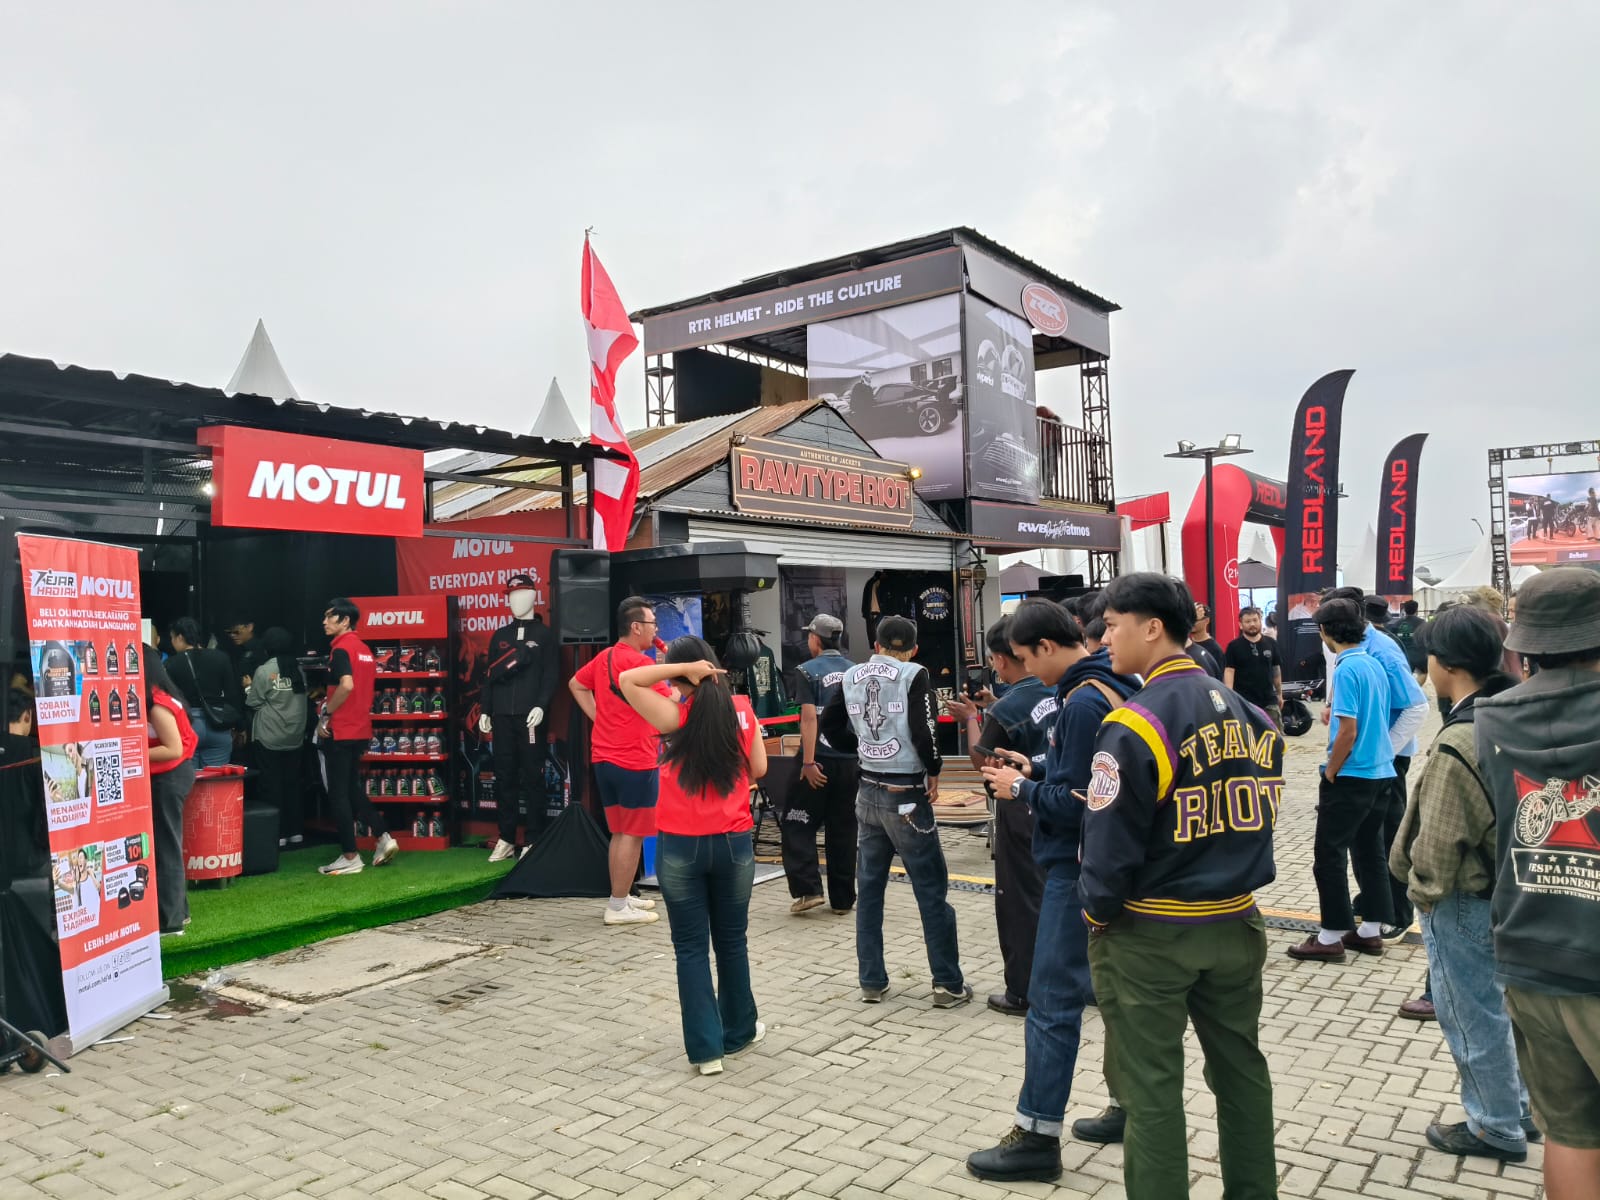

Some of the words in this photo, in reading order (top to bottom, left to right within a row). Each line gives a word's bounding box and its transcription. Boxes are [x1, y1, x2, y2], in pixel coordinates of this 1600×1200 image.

[688, 314, 711, 334] RTR
[714, 306, 762, 329] HELMET
[774, 296, 804, 316] RIDE
[807, 290, 834, 308] THE
[837, 274, 902, 301] CULTURE
[248, 460, 406, 510] MOTUL
[1302, 405, 1327, 574] REDLAND
[1017, 521, 1047, 534] RWB
[1388, 458, 1408, 581] REDLAND
[452, 538, 514, 559] MOTUL
[80, 575, 135, 599] MOTUL
[429, 571, 494, 590] EVERYDAY
[40, 608, 57, 617] BELI
[58, 608, 71, 617] OLI
[367, 610, 425, 626] MOTUL
[861, 743, 897, 756] OREVER
[1179, 719, 1277, 777] TEAM
[1173, 776, 1286, 842] RIOT
[83, 936, 105, 952] LEBIH
[105, 930, 120, 944] BAIK
[119, 921, 141, 938] MOTUL
